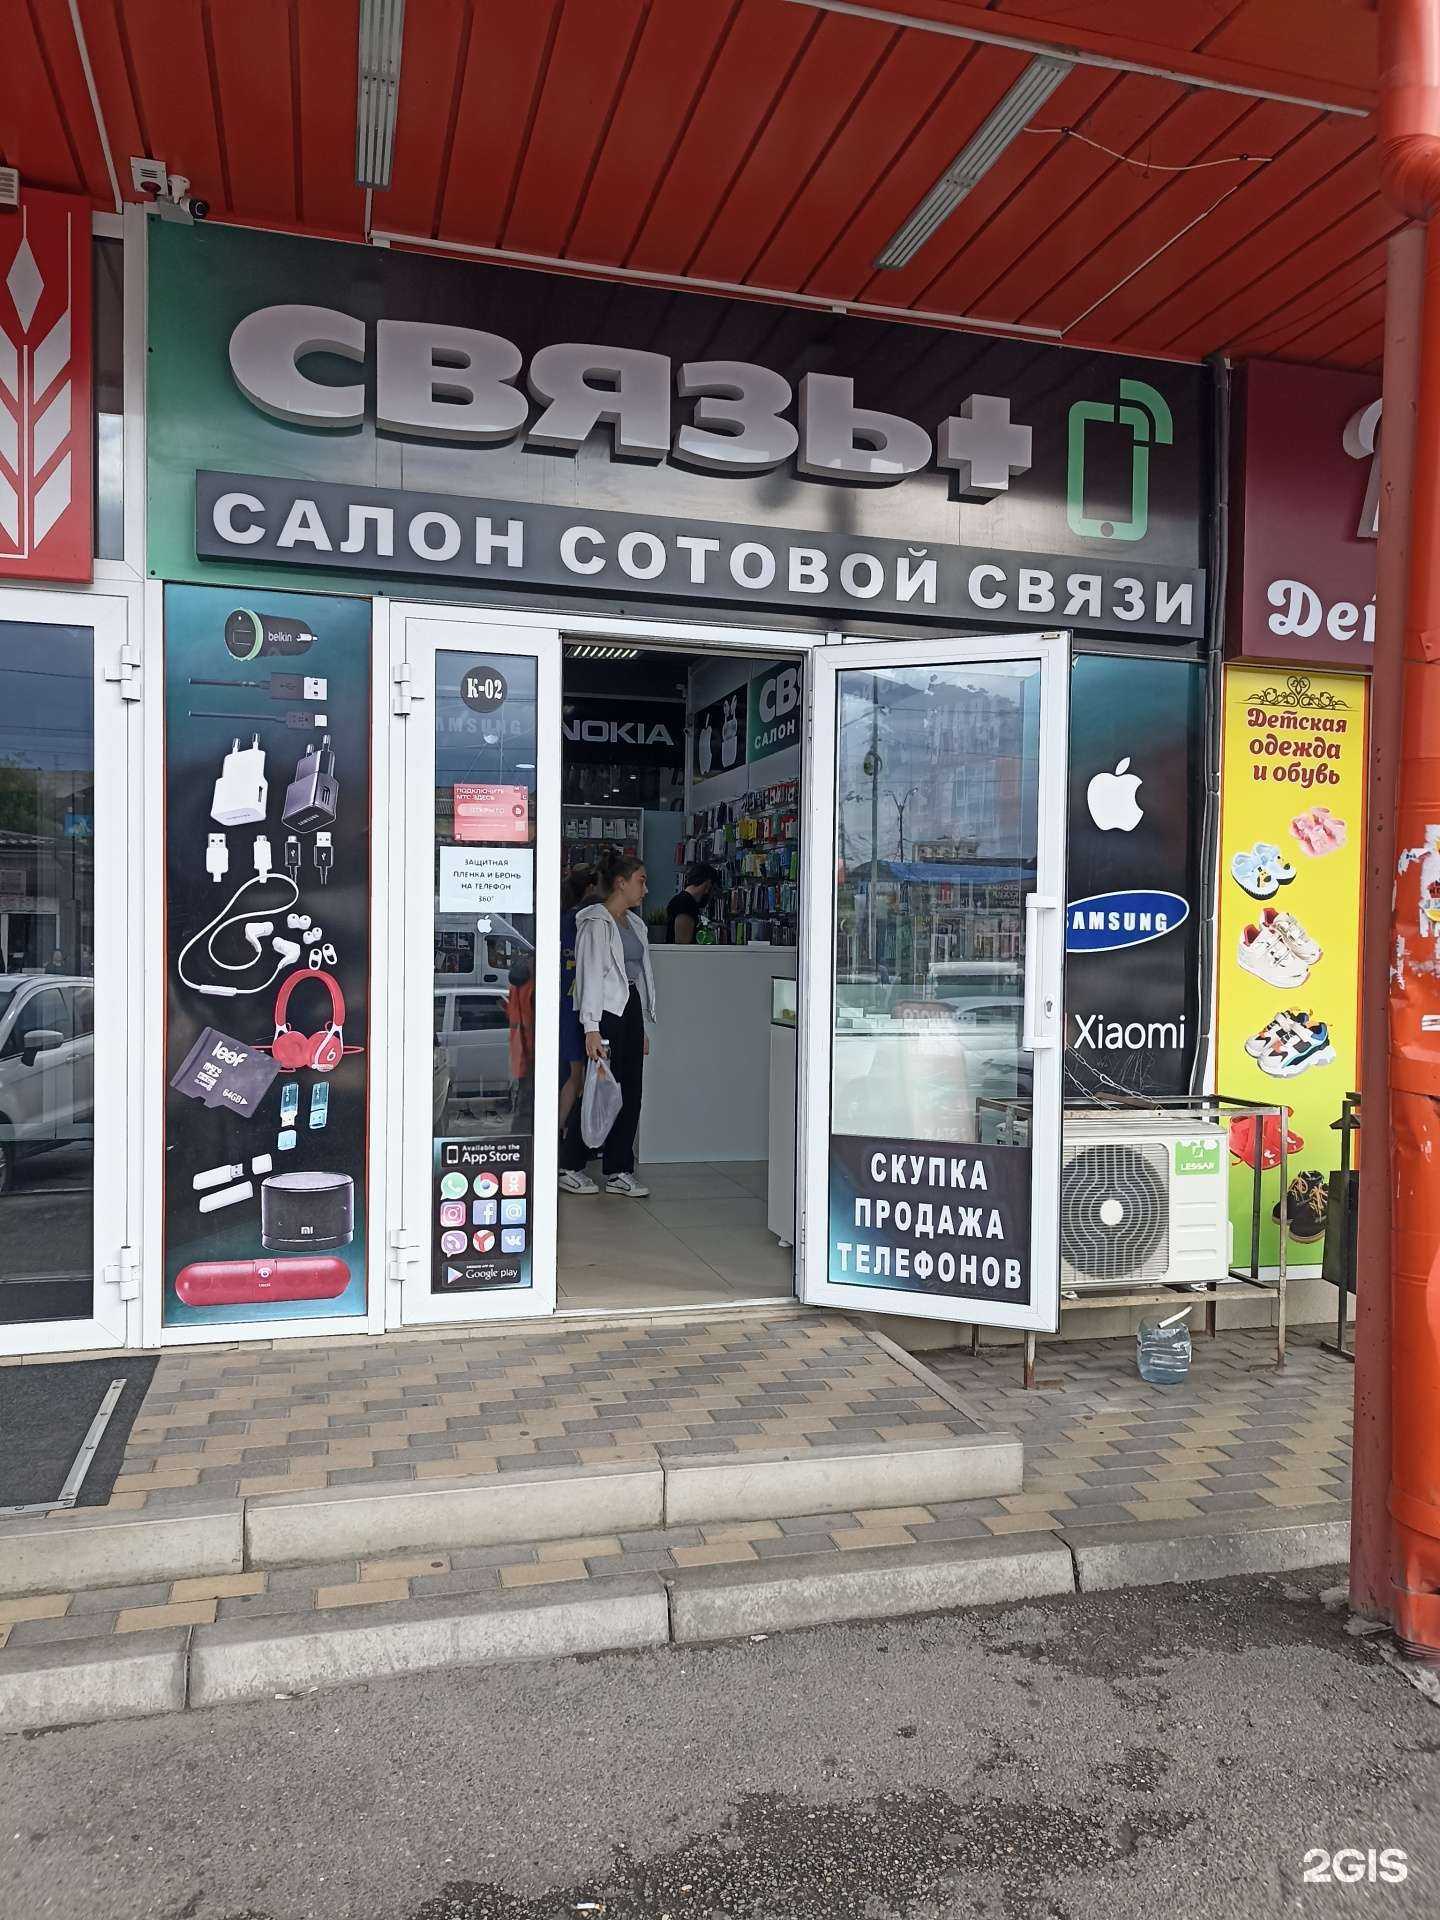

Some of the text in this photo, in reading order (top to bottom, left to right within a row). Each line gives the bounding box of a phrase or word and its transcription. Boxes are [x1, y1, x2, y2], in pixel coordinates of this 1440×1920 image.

[213, 492, 1192, 625] САЛОН СОТОВОЙ СВЯЗИ
[268, 631, 292, 642] belkin
[759, 666, 802, 723] СВ
[436, 716, 521, 735] AMSUNG
[561, 719, 675, 746] NOKIA
[1247, 707, 1347, 733] Детская
[754, 719, 795, 750] САЛОН
[1249, 733, 1341, 759] одежда
[1253, 761, 1340, 789] и обувь
[453, 870, 486, 879] ПЛЕНКА
[464, 858, 509, 867] ЗАЩИТНАЯ
[461, 882, 512, 891] НА ТЕЛЕФОН
[1067, 911, 1168, 931] AMSUNG
[1074, 1014, 1186, 1049] Xiaomi
[222, 1088, 242, 1104] 64GB
[462, 1151, 520, 1164] App Store
[871, 1152, 988, 1190] СКУПКА
[855, 1198, 1004, 1239] ПРОДАЖА
[466, 1269, 518, 1280] Google play
[837, 1242, 1022, 1288] ТЕЛЕФОНОВ
